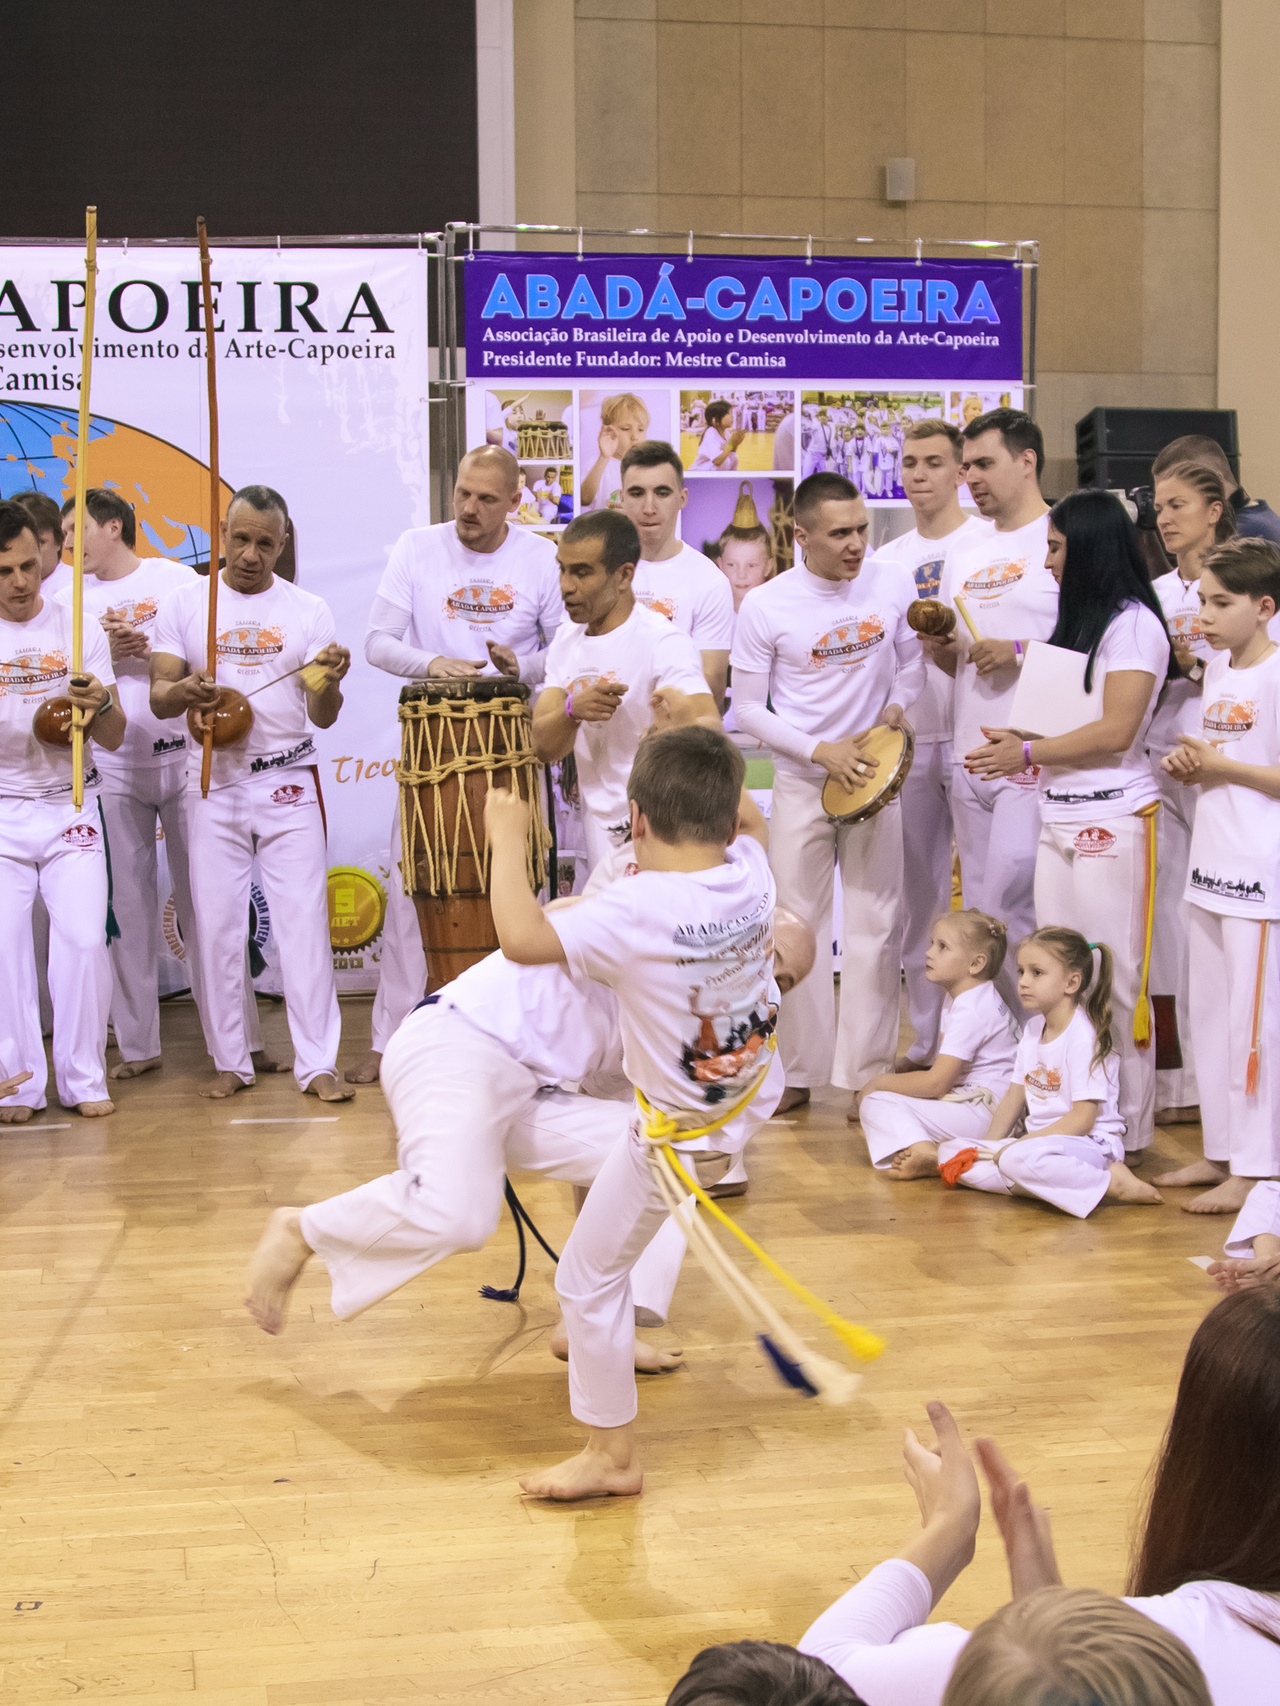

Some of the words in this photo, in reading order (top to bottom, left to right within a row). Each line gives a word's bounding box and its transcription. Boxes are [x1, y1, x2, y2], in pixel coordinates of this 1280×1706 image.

[480, 262, 1001, 324] ABADÁ-CAPOEIRA
[483, 327, 569, 346] Associação
[573, 327, 647, 343] Brasileira
[651, 327, 670, 343] de
[674, 328, 722, 347] Apoio
[726, 332, 734, 343] e
[738, 328, 871, 345] Desenvolvimento
[874, 330, 893, 345] da
[897, 330, 1000, 349] Arte-Capoeira
[225, 338, 396, 365] Arte-Capoeira
[483, 350, 572, 367] Presidente
[576, 350, 661, 367] Fundador:
[666, 351, 723, 367] Mestre
[727, 351, 786, 367] Camisa
